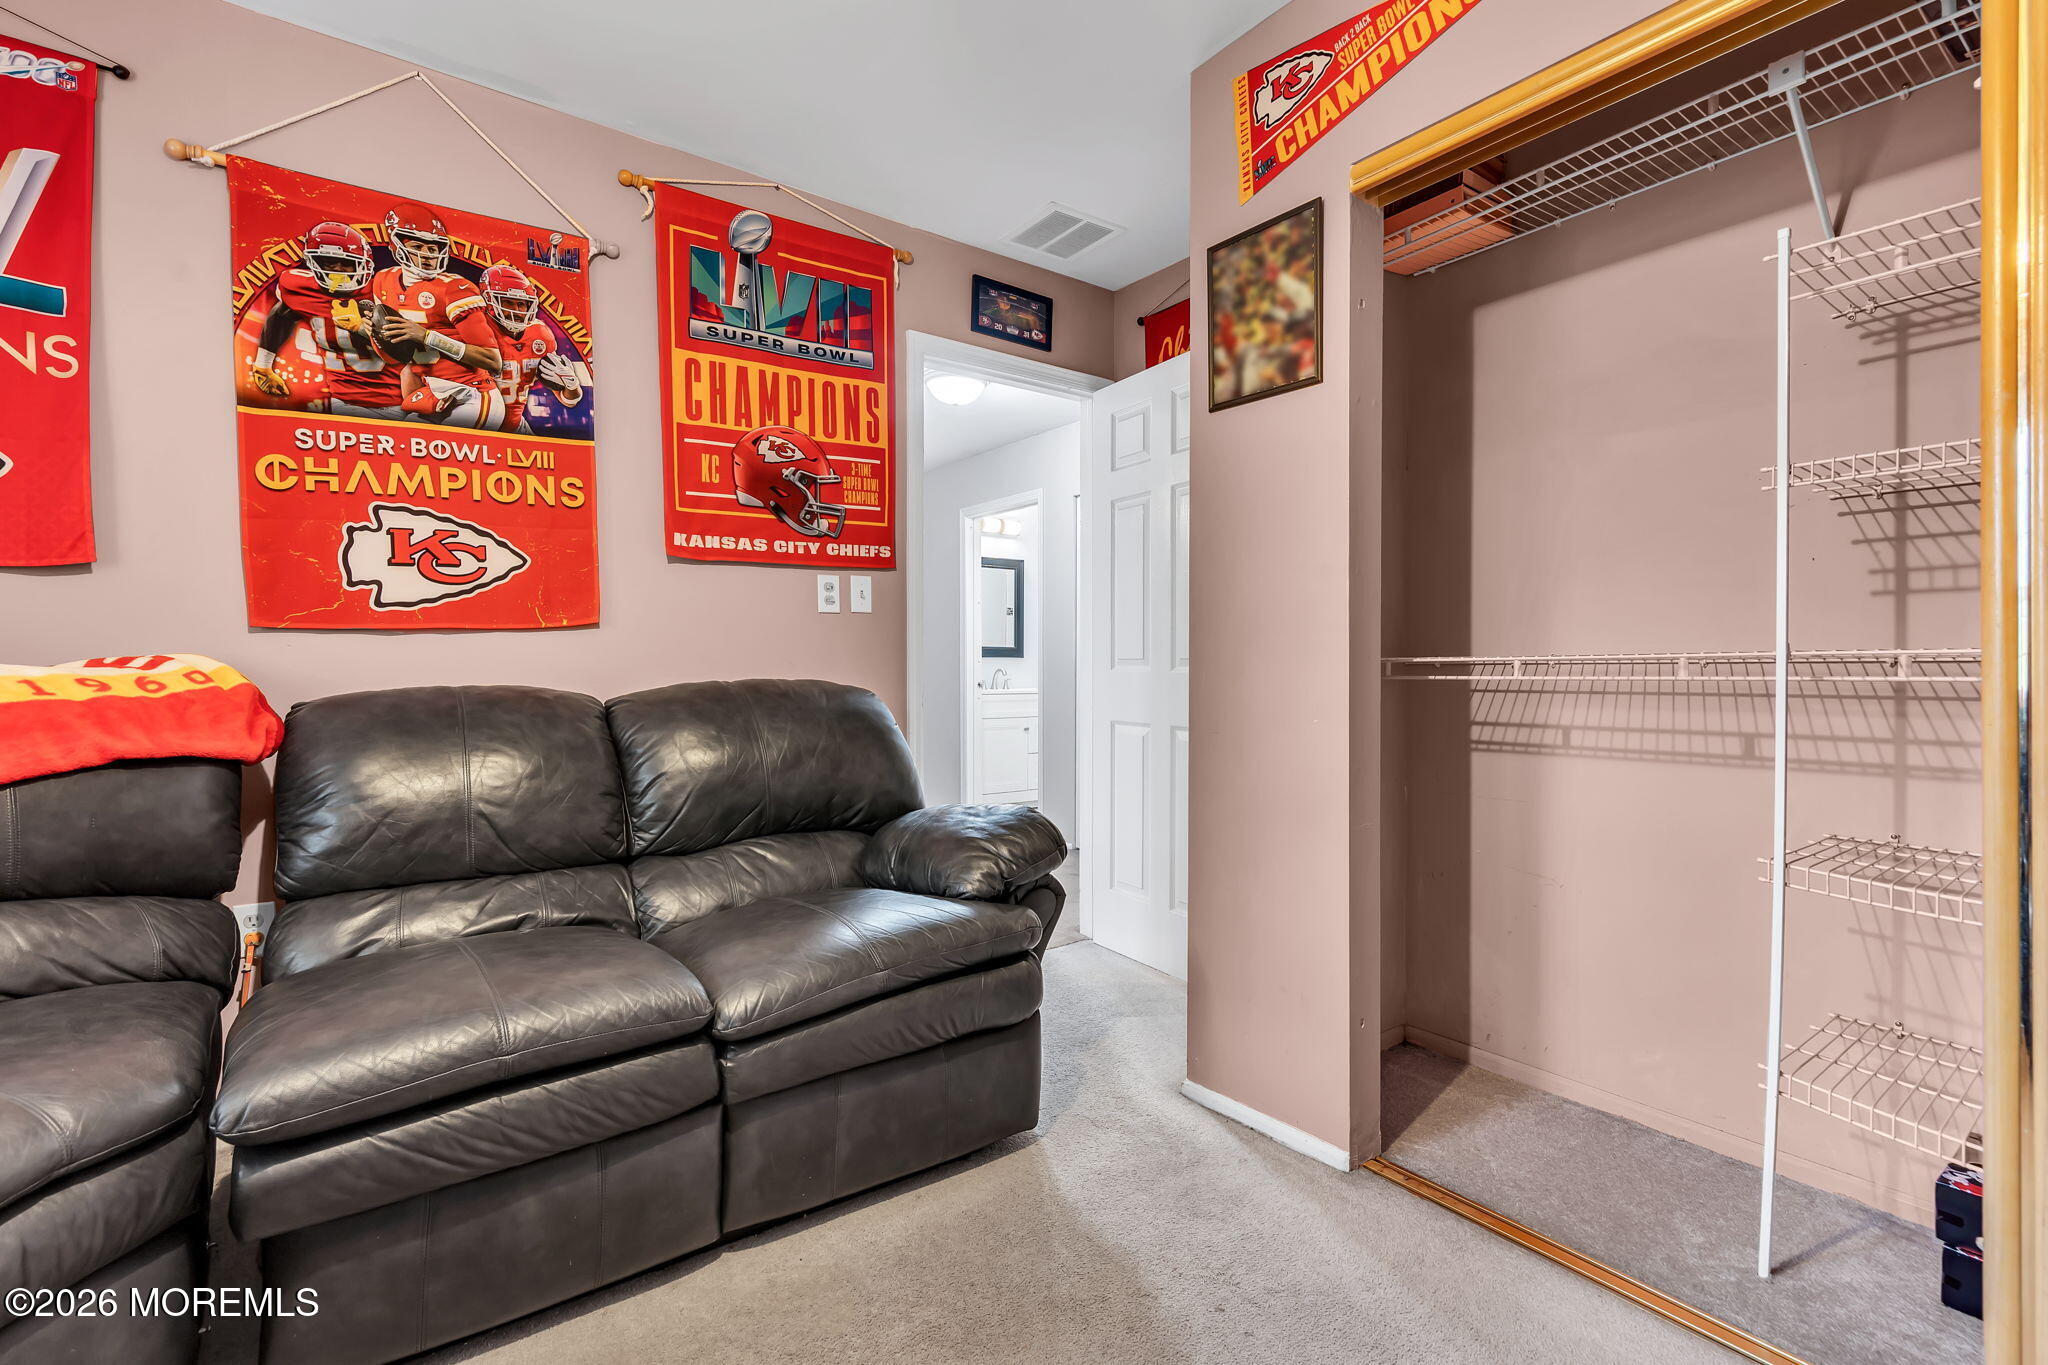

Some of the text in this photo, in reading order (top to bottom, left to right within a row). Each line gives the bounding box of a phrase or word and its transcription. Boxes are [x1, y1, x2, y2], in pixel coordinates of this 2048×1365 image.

[1334, 13, 1372, 53] BACK 2 BACK
[1337, 0, 1416, 71] SUPER BOWL
[1275, 0, 1476, 163] CHAMPION
[1237, 75, 1251, 193] KANSAS CITY CHIEFS
[706, 325, 860, 363] SUPER BOWL
[684, 357, 880, 444] CHAMPIONS
[294, 427, 555, 470] SUPER BOWL LVIII
[701, 453, 720, 484] KC
[254, 453, 586, 509] CHAMPIONS
[842, 475, 879, 492] SUPER BOWL
[843, 490, 879, 506] CHAMPIONS
[387, 526, 488, 586] KC
[673, 532, 892, 558] KANSAS CITY CHIEFS
[17, 668, 215, 697] 1960
